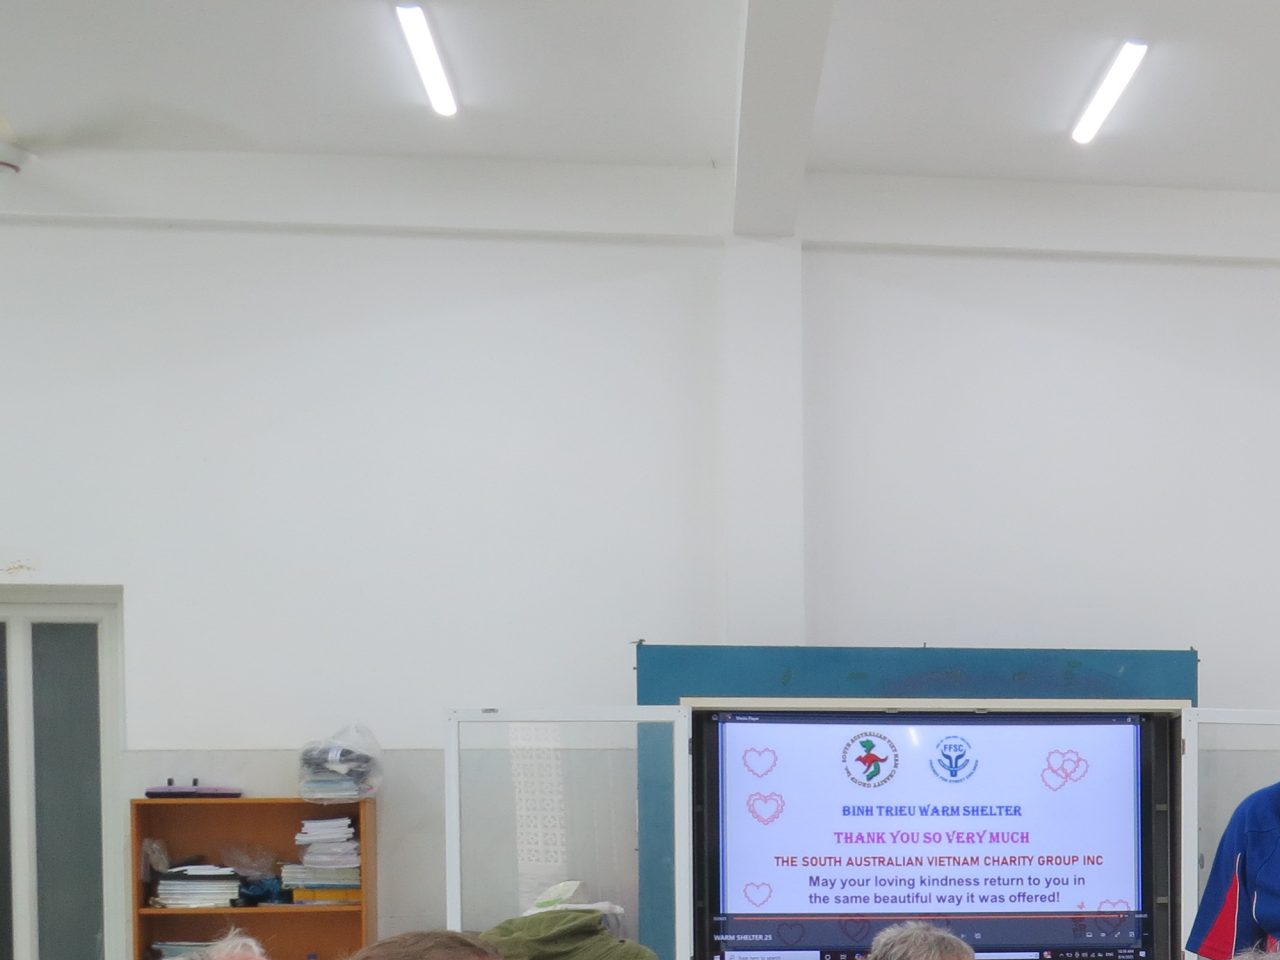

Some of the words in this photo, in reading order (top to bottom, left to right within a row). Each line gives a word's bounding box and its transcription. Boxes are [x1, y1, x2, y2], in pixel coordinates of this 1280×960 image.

[943, 744, 964, 752] FFSC
[842, 805, 874, 817] BINH
[876, 805, 916, 817] TRIEU
[918, 804, 960, 817] WARM
[963, 805, 1022, 817] SHELTER
[834, 831, 886, 844] THANK
[889, 830, 920, 844] YOU
[923, 832, 942, 844] SO
[945, 830, 987, 844] VERY
[988, 832, 1030, 844] MUCH
[774, 856, 798, 866] THE
[802, 856, 842, 866] SOUTH
[846, 856, 924, 866] AUSTRALIAN
[927, 856, 980, 866] VIETNAM
[984, 856, 1034, 866] CHARITY
[1038, 855, 1079, 866] GROUP
[1083, 855, 1104, 866] INC
[808, 875, 836, 890] May
[840, 878, 871, 890] your
[875, 875, 916, 889] loving
[920, 875, 980, 887] kindness
[984, 876, 1024, 886] return
[1028, 876, 1040, 886] to
[1044, 877, 1069, 888] you
[1074, 874, 1086, 886] in
[808, 893, 830, 904] the
[834, 896, 870, 904] same
[874, 892, 932, 904] beautiful
[936, 894, 963, 906] way
[966, 892, 975, 904] it
[978, 894, 1005, 903] was
[1008, 892, 1060, 903] offered!
